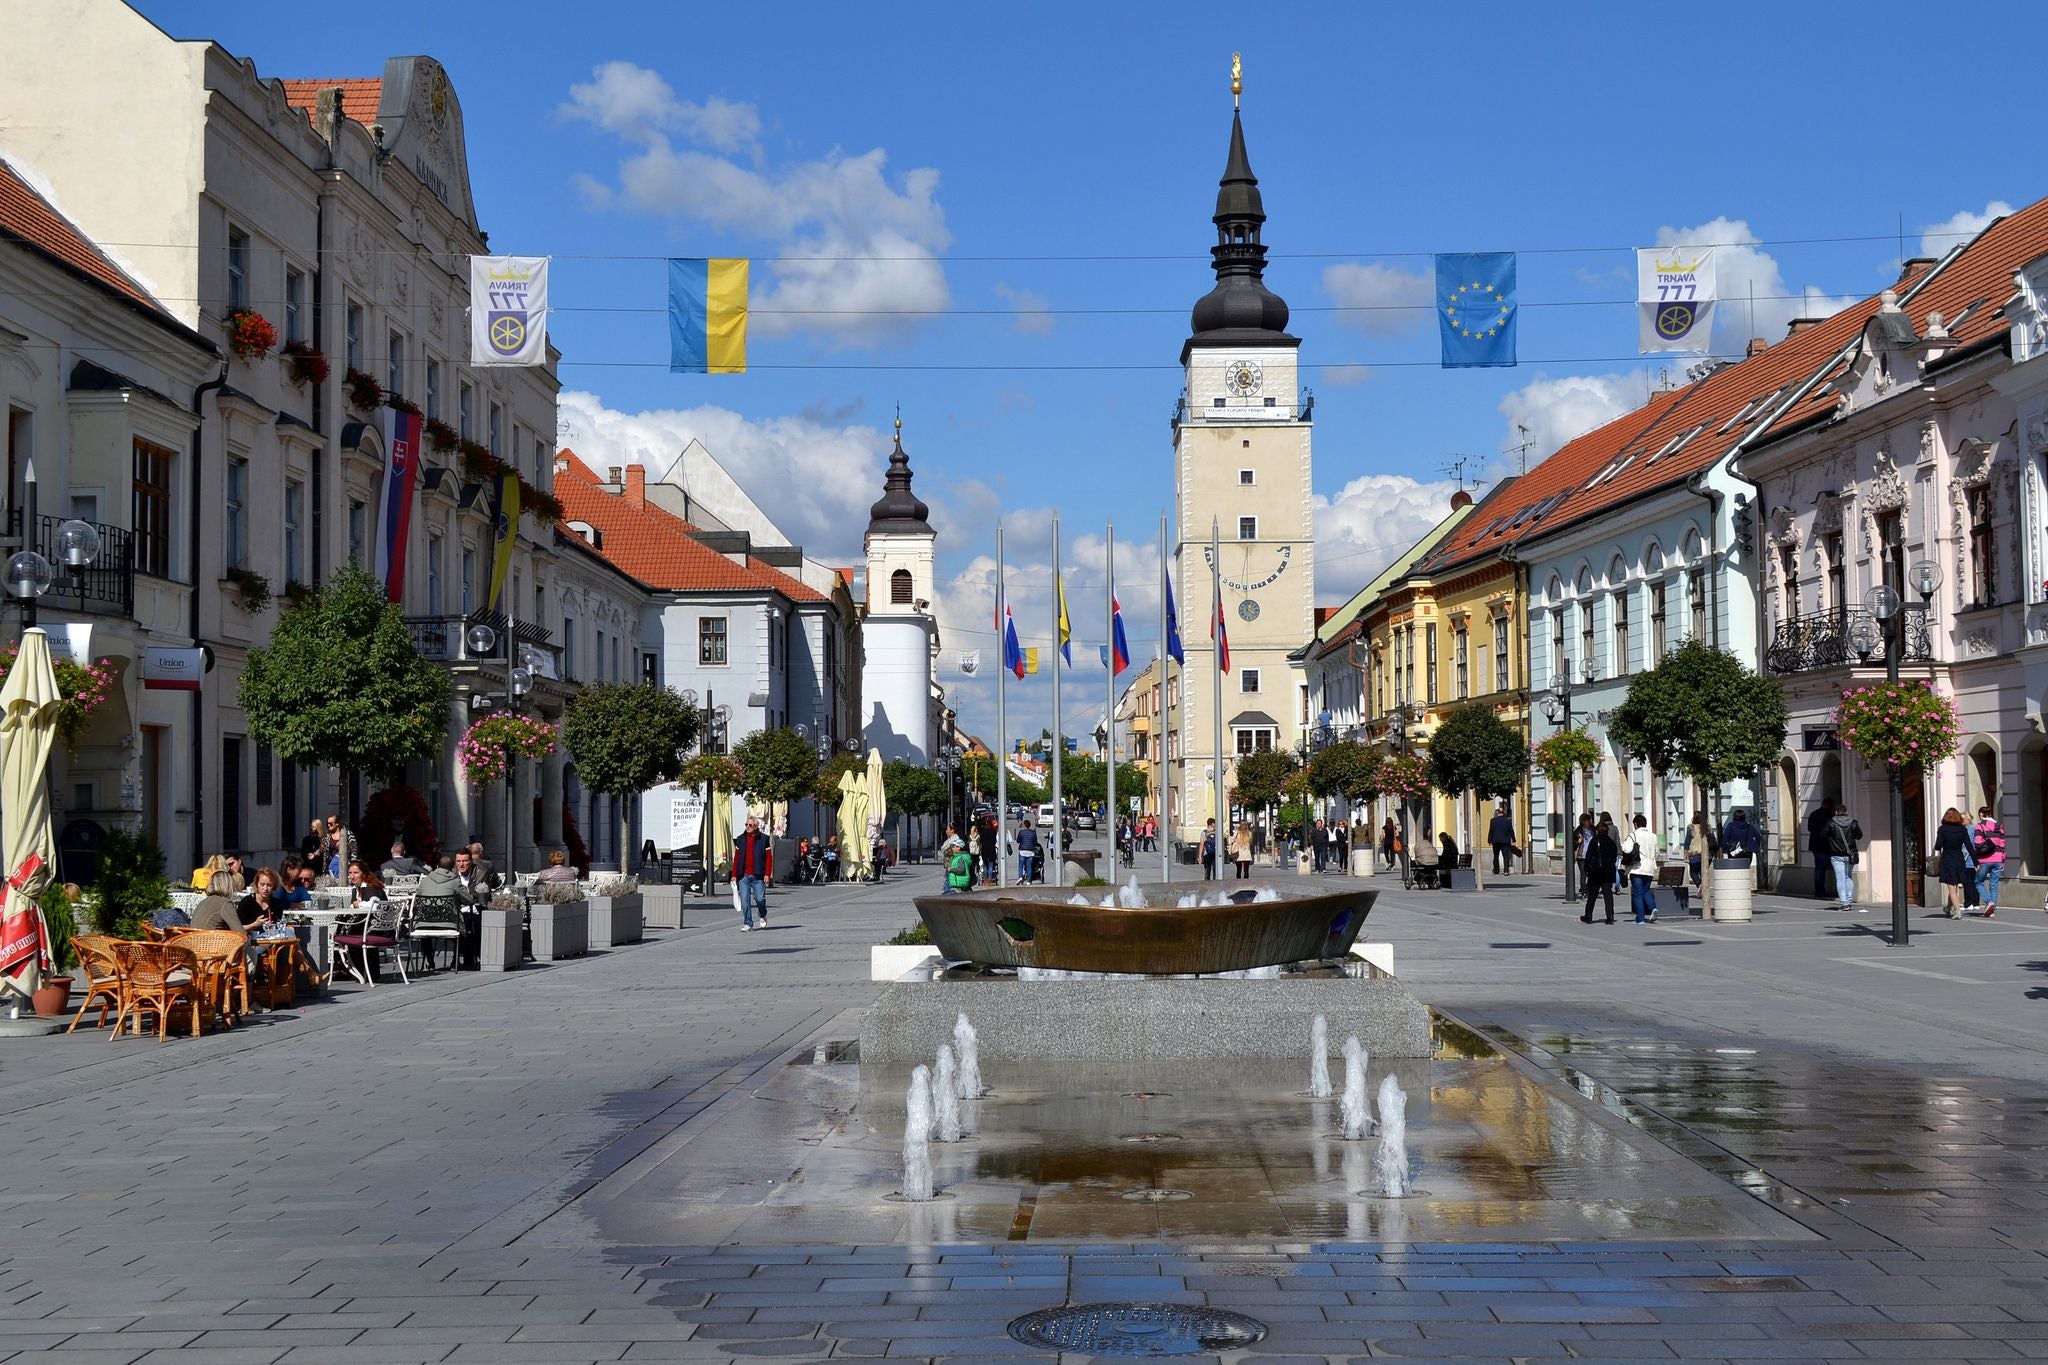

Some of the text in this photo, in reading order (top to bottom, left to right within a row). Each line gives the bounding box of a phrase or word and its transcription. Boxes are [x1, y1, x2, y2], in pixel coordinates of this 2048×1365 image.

[1656, 273, 1697, 283] TRNAVA
[1657, 284, 1697, 301] 777
[47, 635, 71, 645] nion
[159, 657, 184, 667] Union
